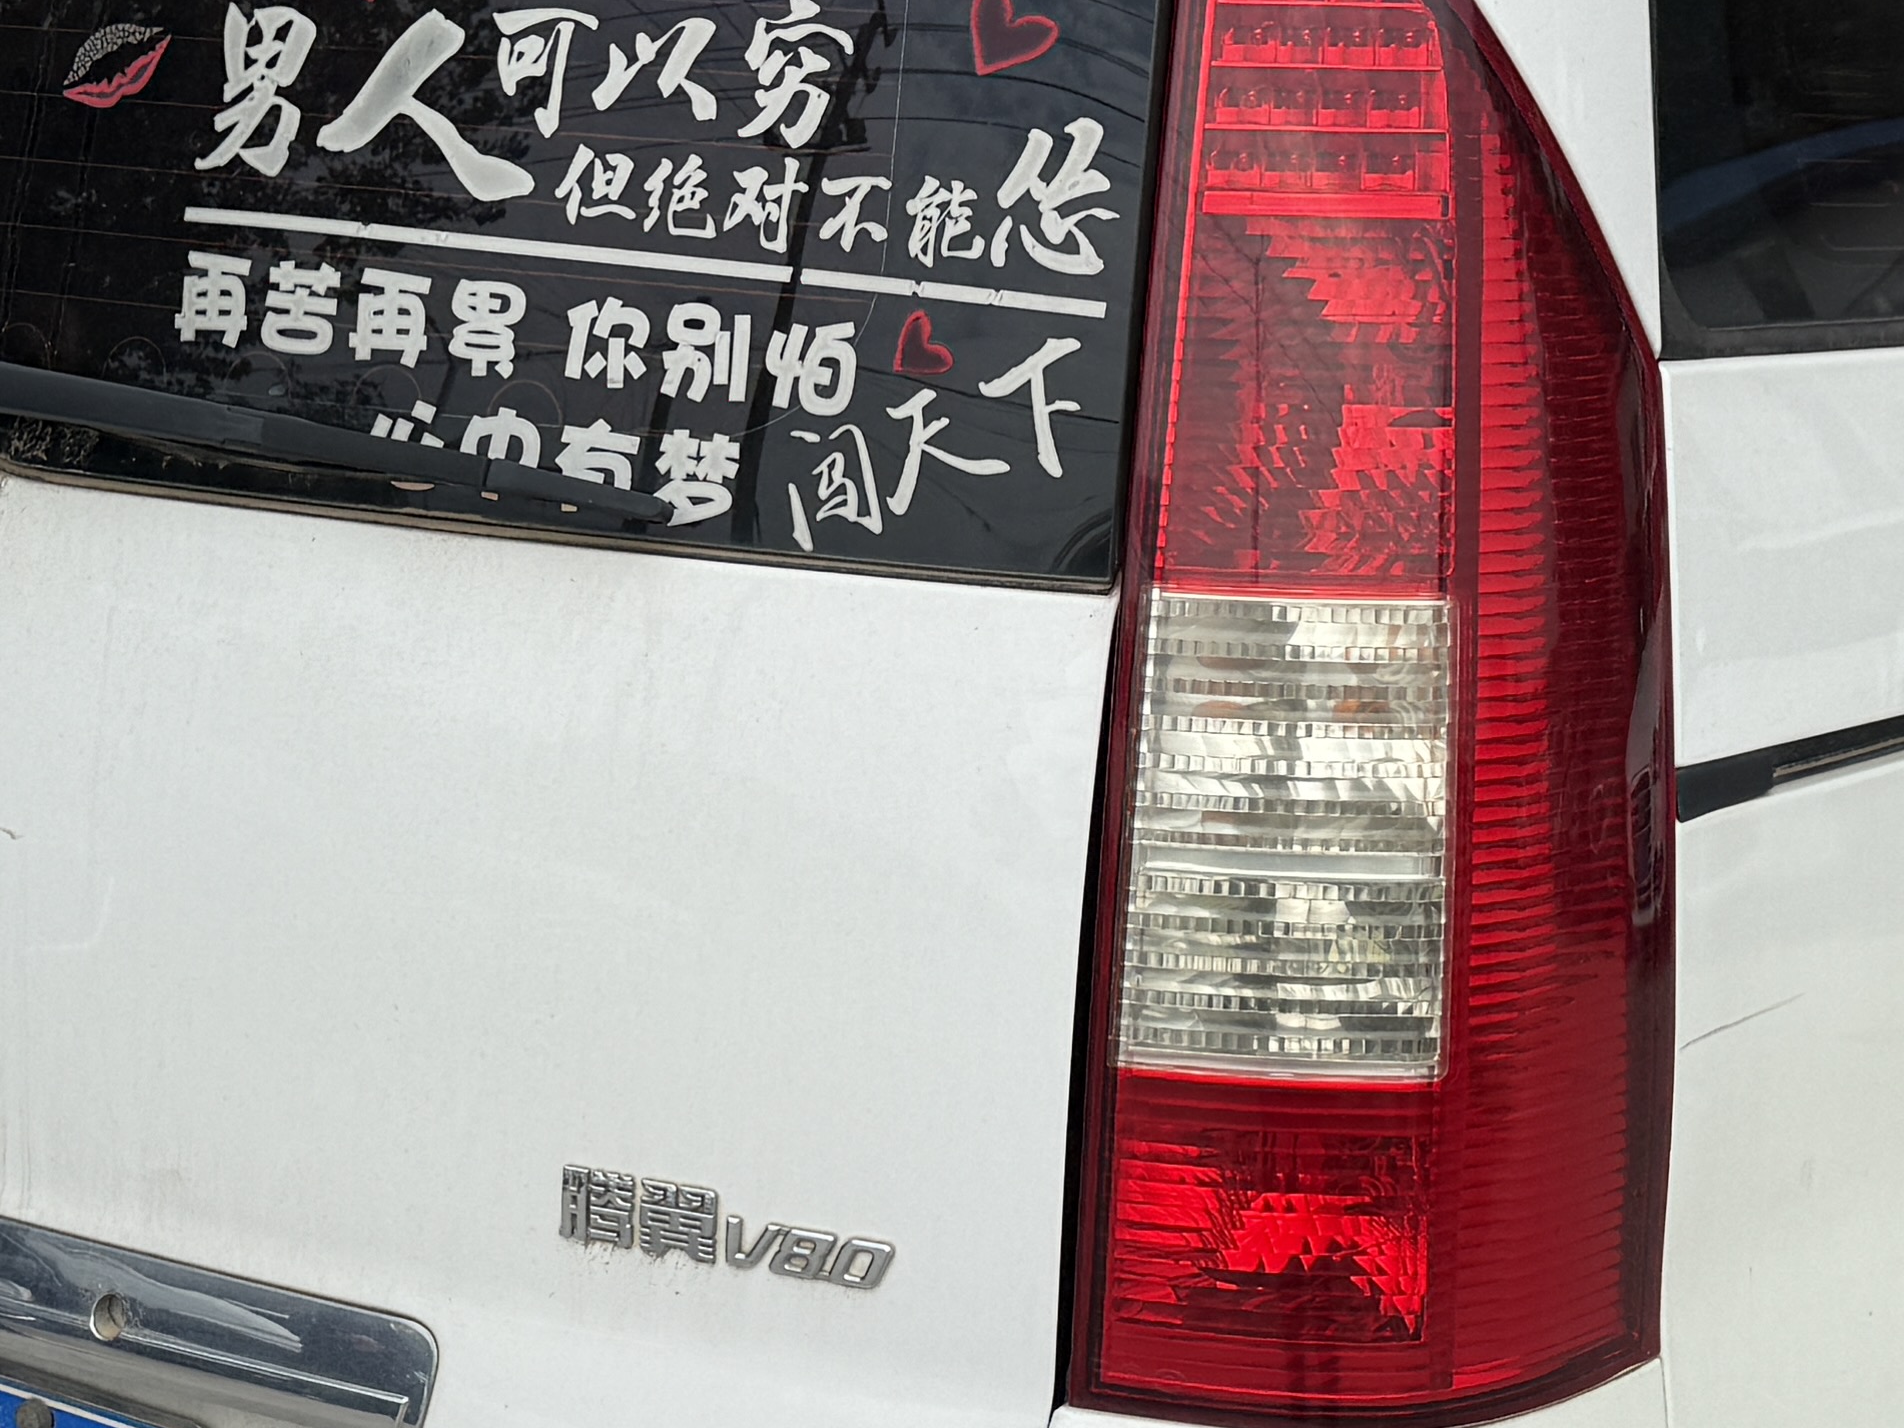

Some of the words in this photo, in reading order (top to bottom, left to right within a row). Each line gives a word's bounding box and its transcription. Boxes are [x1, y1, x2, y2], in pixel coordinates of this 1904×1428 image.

[553, 117, 1119, 276] 但绝对不能怂
[174, 249, 527, 378] 再苦再累
[565, 297, 858, 417] 你别怕
[787, 337, 1082, 551] 闯天下
